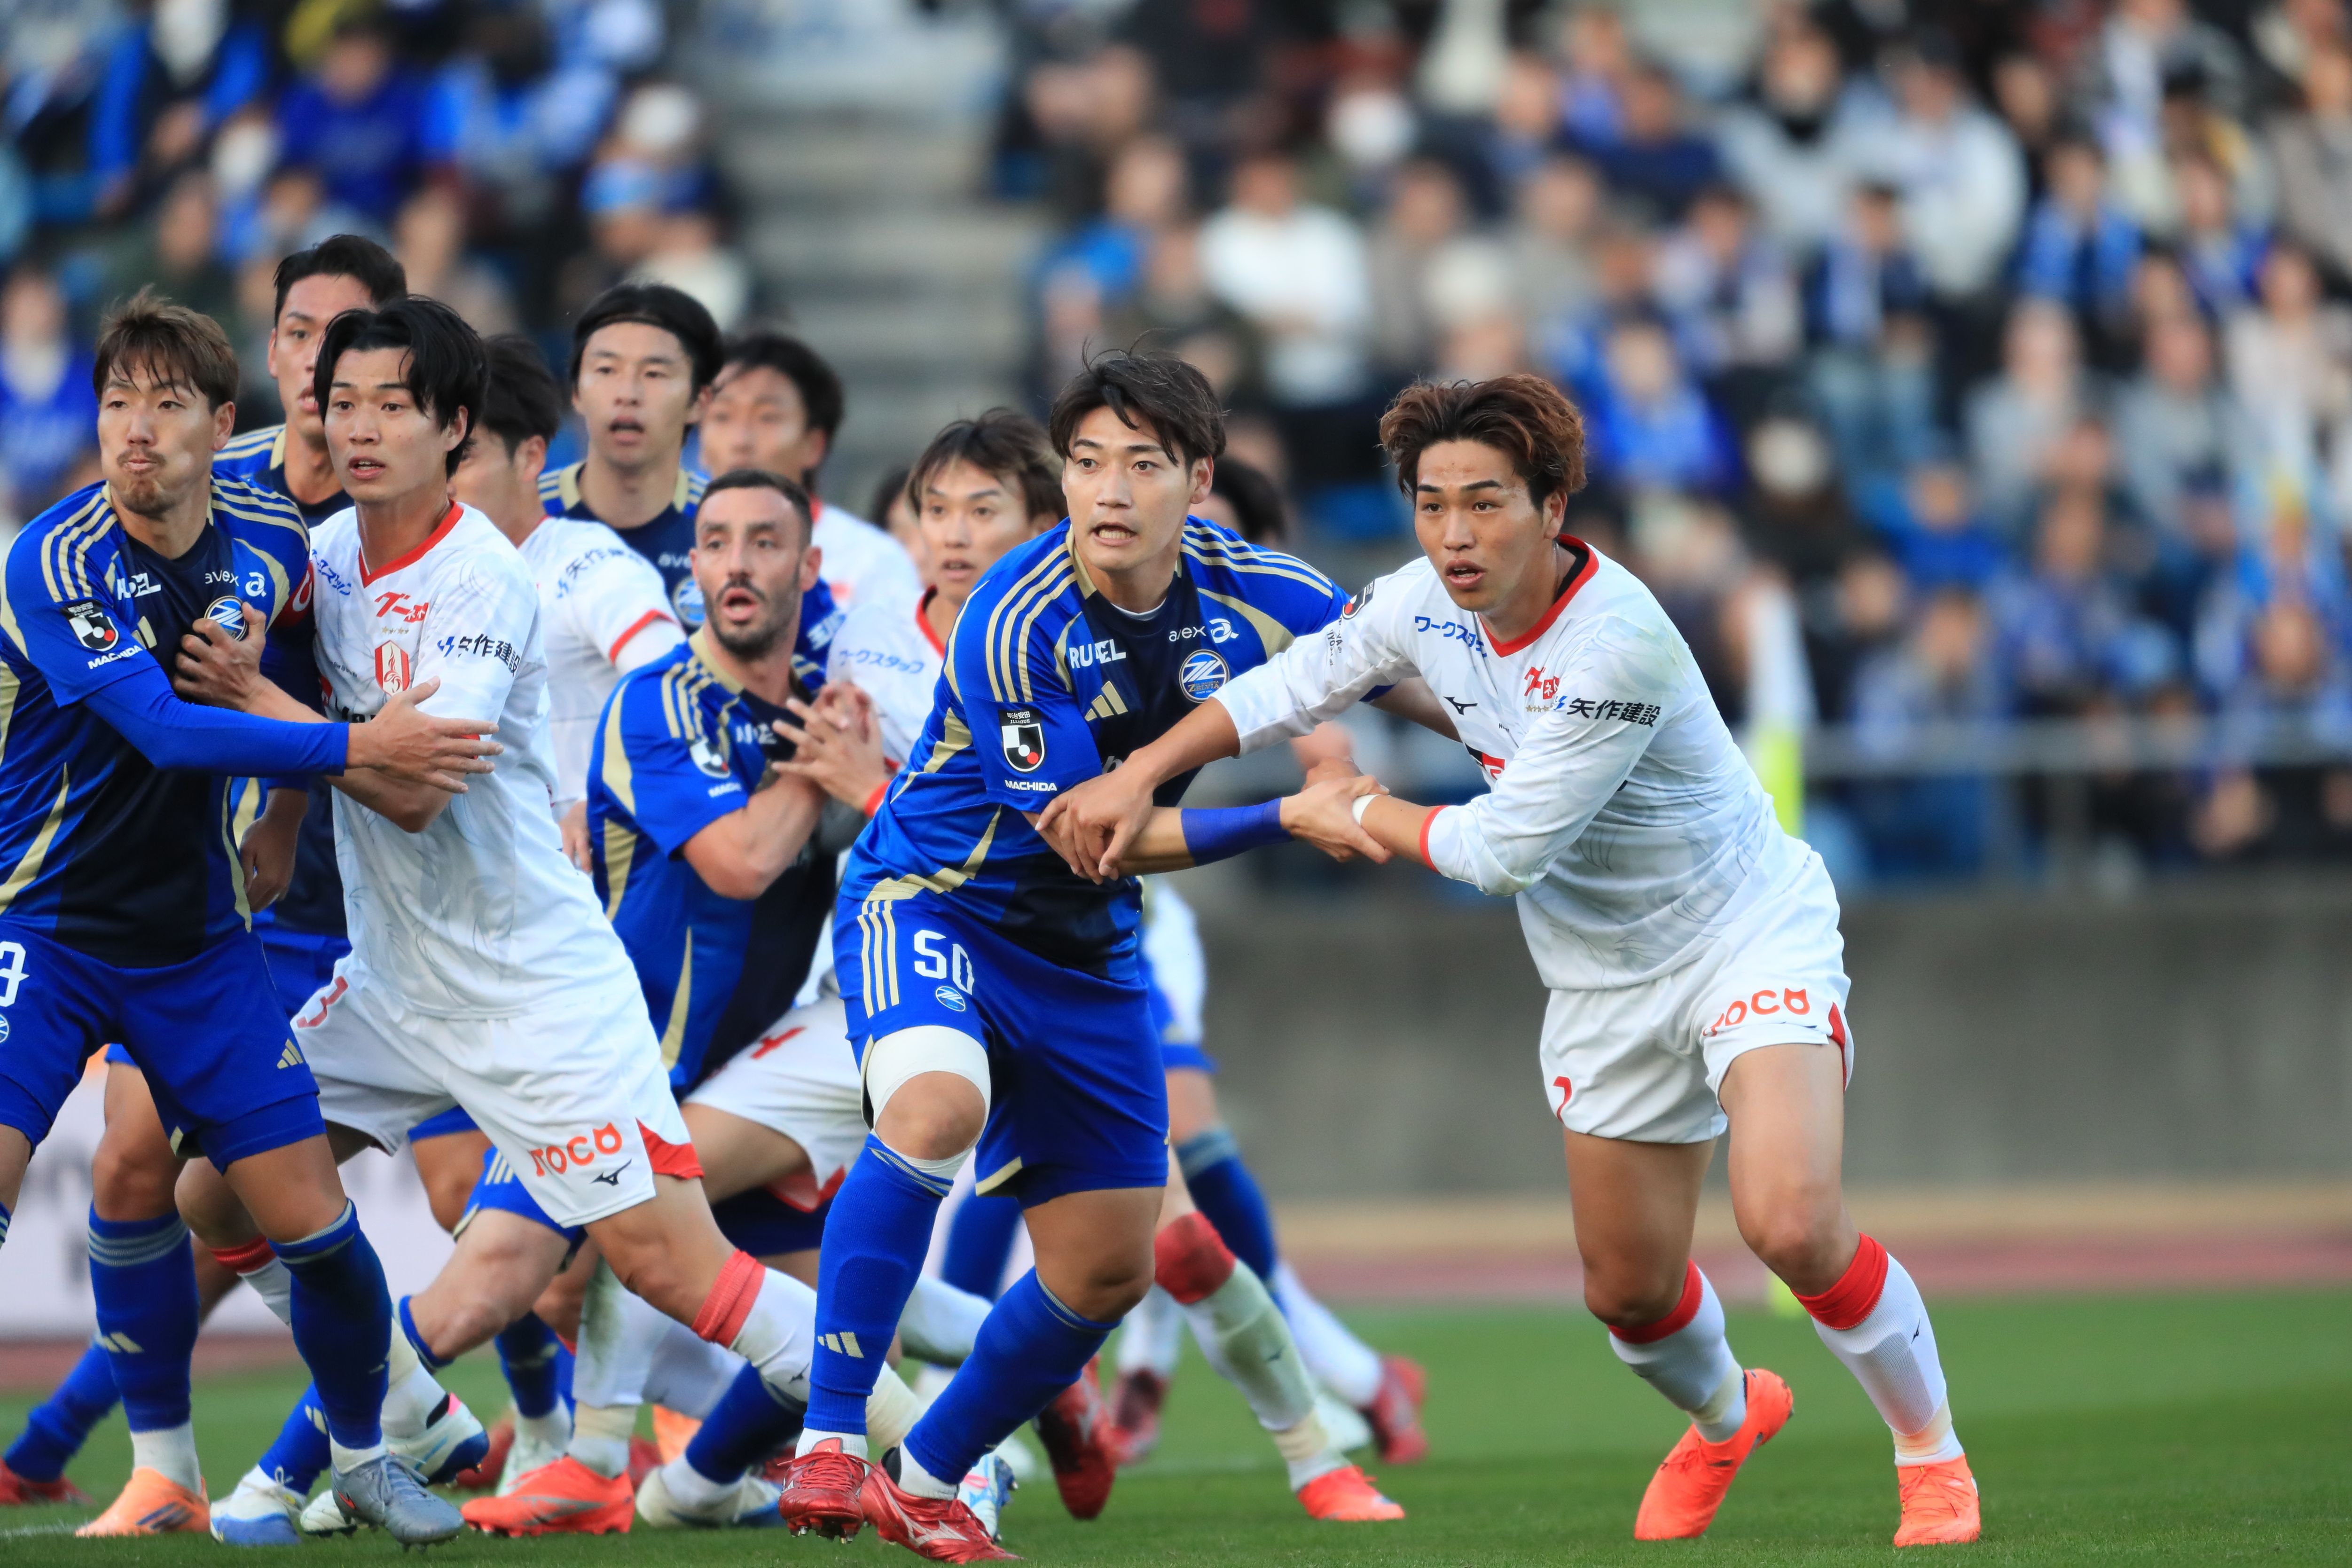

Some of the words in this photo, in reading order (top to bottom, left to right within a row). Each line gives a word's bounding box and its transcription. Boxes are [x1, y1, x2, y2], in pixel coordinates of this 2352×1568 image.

[205, 570, 239, 587] avex
[1567, 698, 1661, 727] 矢作建設
[1005, 780, 1057, 792] MACHIDA
[914, 929, 974, 996] 50
